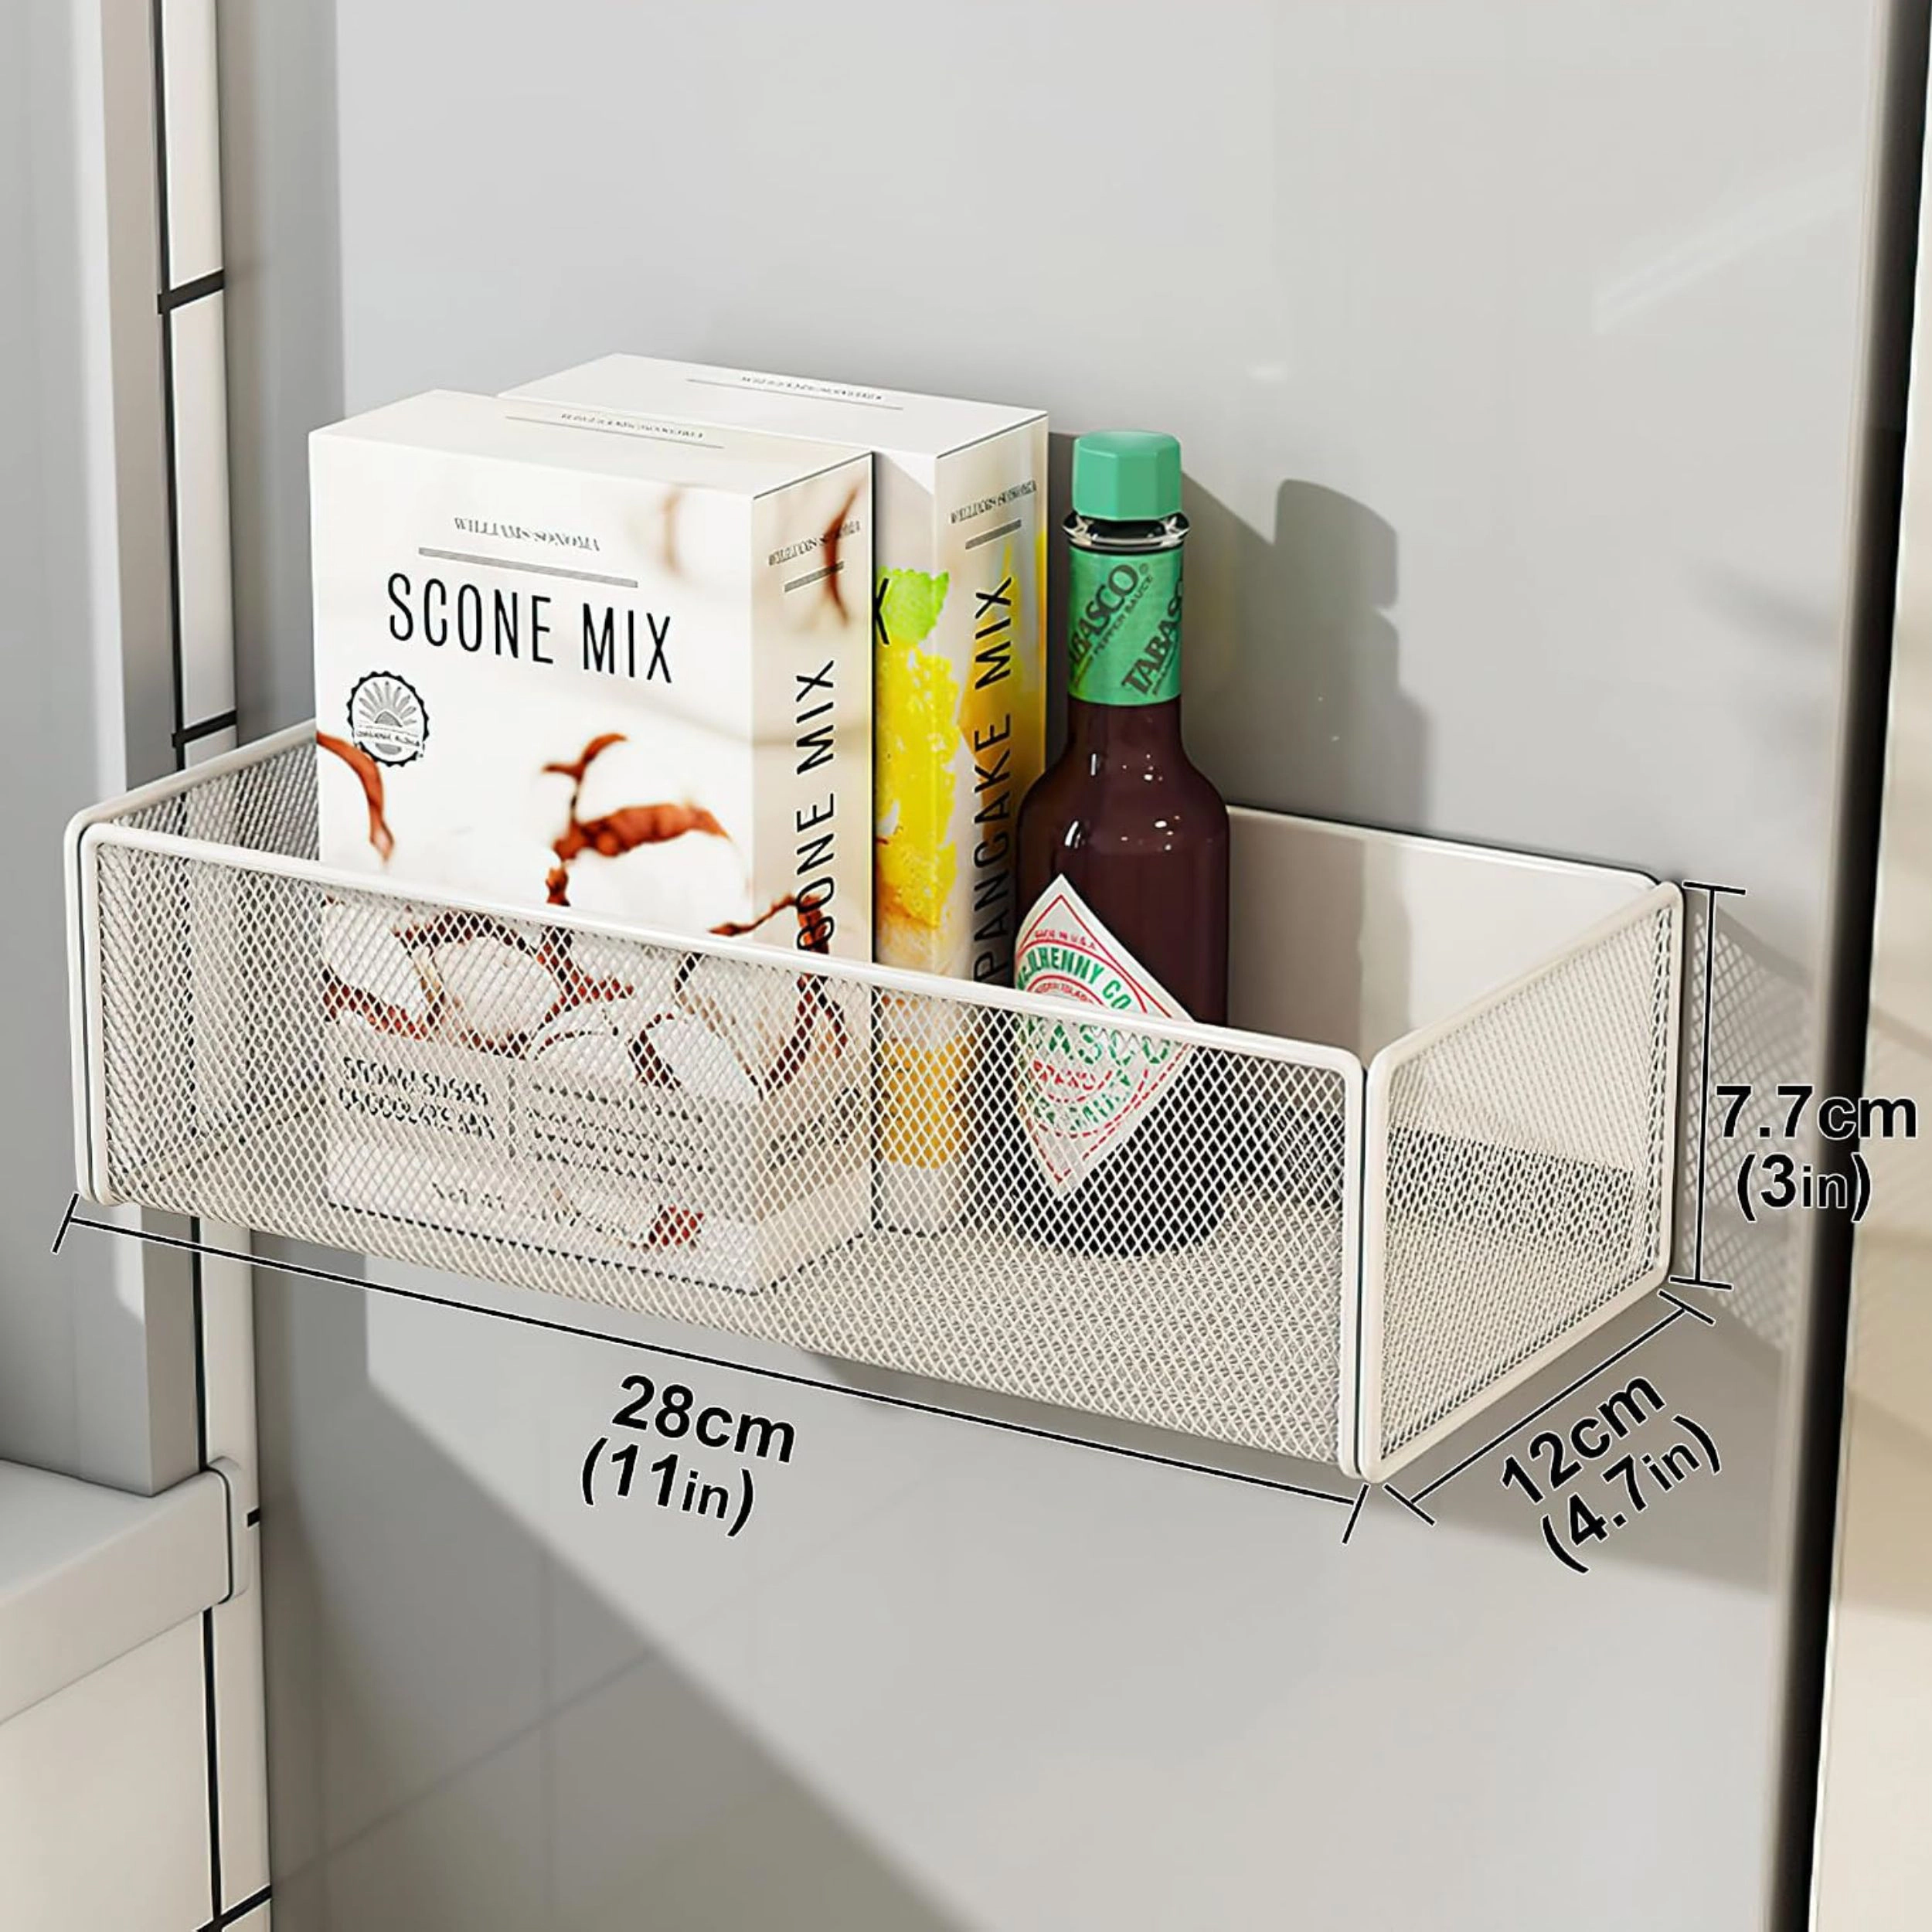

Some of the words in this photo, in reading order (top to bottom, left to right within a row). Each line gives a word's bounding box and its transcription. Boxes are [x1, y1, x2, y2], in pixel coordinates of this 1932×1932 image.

[388, 573, 554, 665] SCONE
[583, 603, 672, 684] MIX
[974, 577, 1012, 690] MIX
[796, 660, 835, 776] MIX
